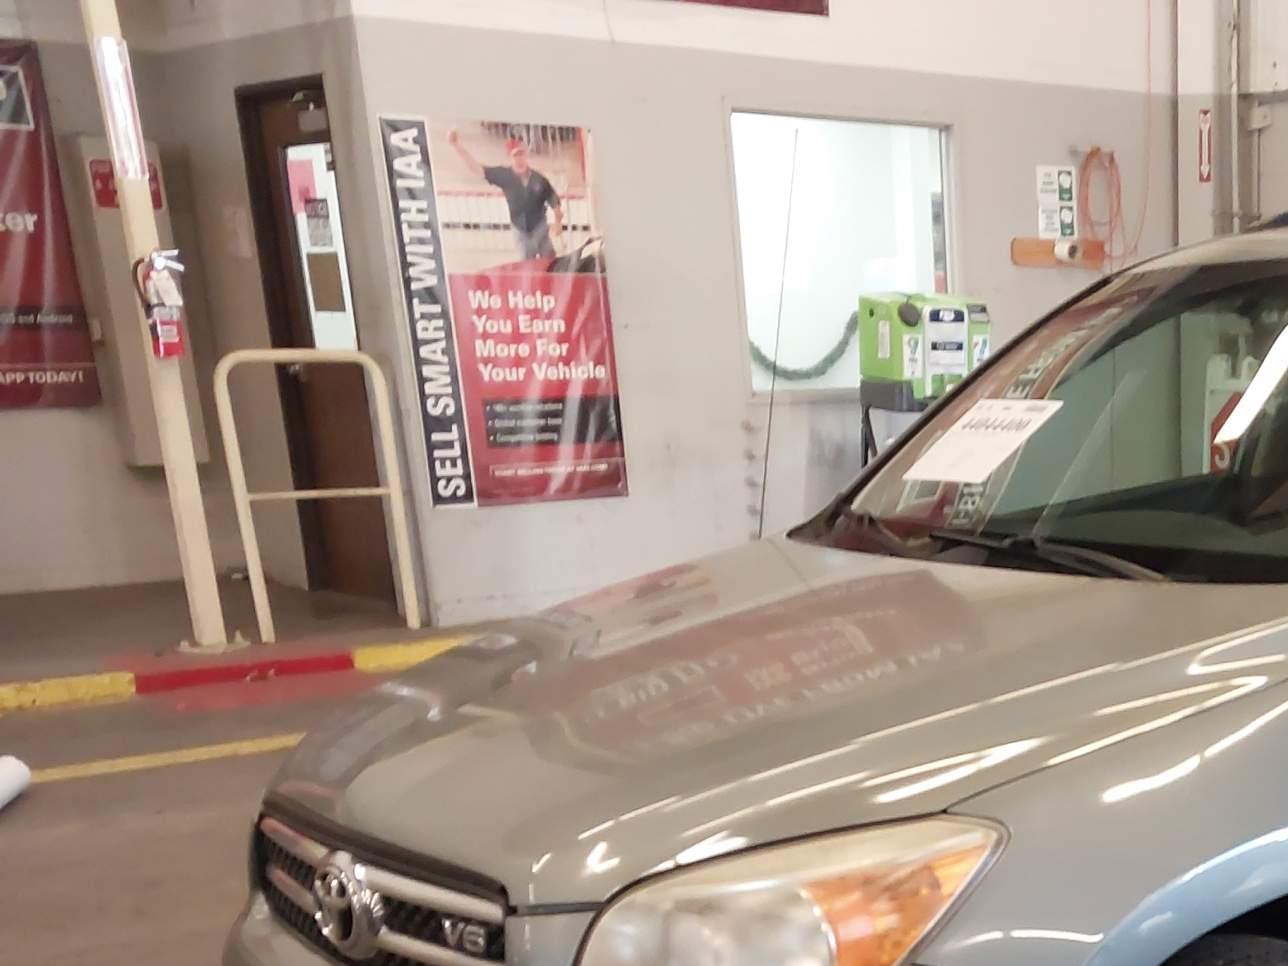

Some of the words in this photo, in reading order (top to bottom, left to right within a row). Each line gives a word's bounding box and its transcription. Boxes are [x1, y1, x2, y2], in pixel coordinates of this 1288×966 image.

[390, 127, 425, 188] IAA
[399, 199, 438, 290] WITH
[468, 289, 502, 310] We
[508, 290, 556, 313] Help
[472, 314, 512, 334] You
[518, 314, 566, 334] Earn
[413, 297, 455, 416] SMART
[475, 339, 531, 358] More
[536, 338, 570, 357] For
[28, 370, 84, 384] TODAY!
[478, 363, 527, 382] Your
[532, 361, 606, 381] Vehicle
[431, 423, 466, 497] SELL
[442, 918, 485, 952] V6
